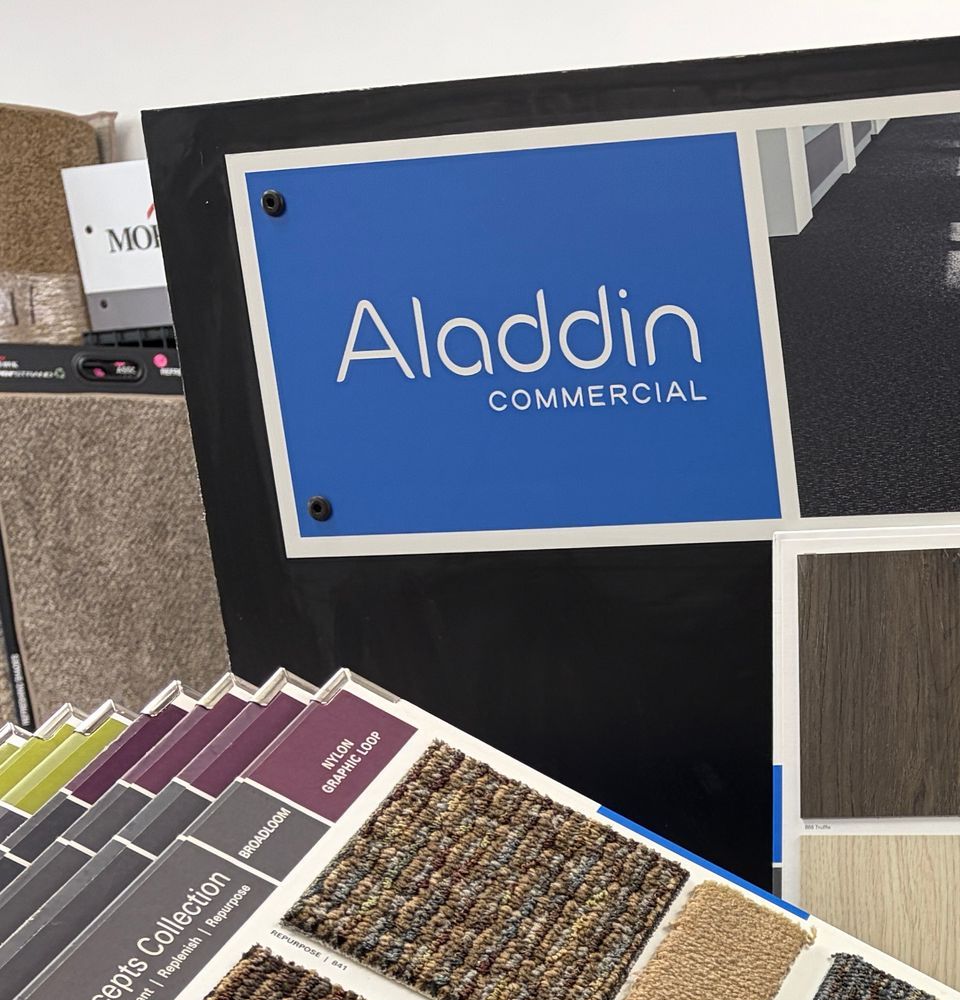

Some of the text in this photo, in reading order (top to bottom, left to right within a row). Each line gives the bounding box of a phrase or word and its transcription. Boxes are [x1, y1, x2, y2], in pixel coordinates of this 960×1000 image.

[336, 285, 702, 383] Aladdin
[488, 380, 707, 411] COMMERCIAL
[321, 738, 355, 770] NYLON
[322, 731, 381, 794] GRAPHIC LOOP
[238, 807, 292, 859] BROADLOOM
[136, 872, 231, 957] Collection
[158, 937, 203, 980] Replenish
[205, 884, 251, 929] Repurpose
[270, 930, 348, 971] REPURPOSE 841
